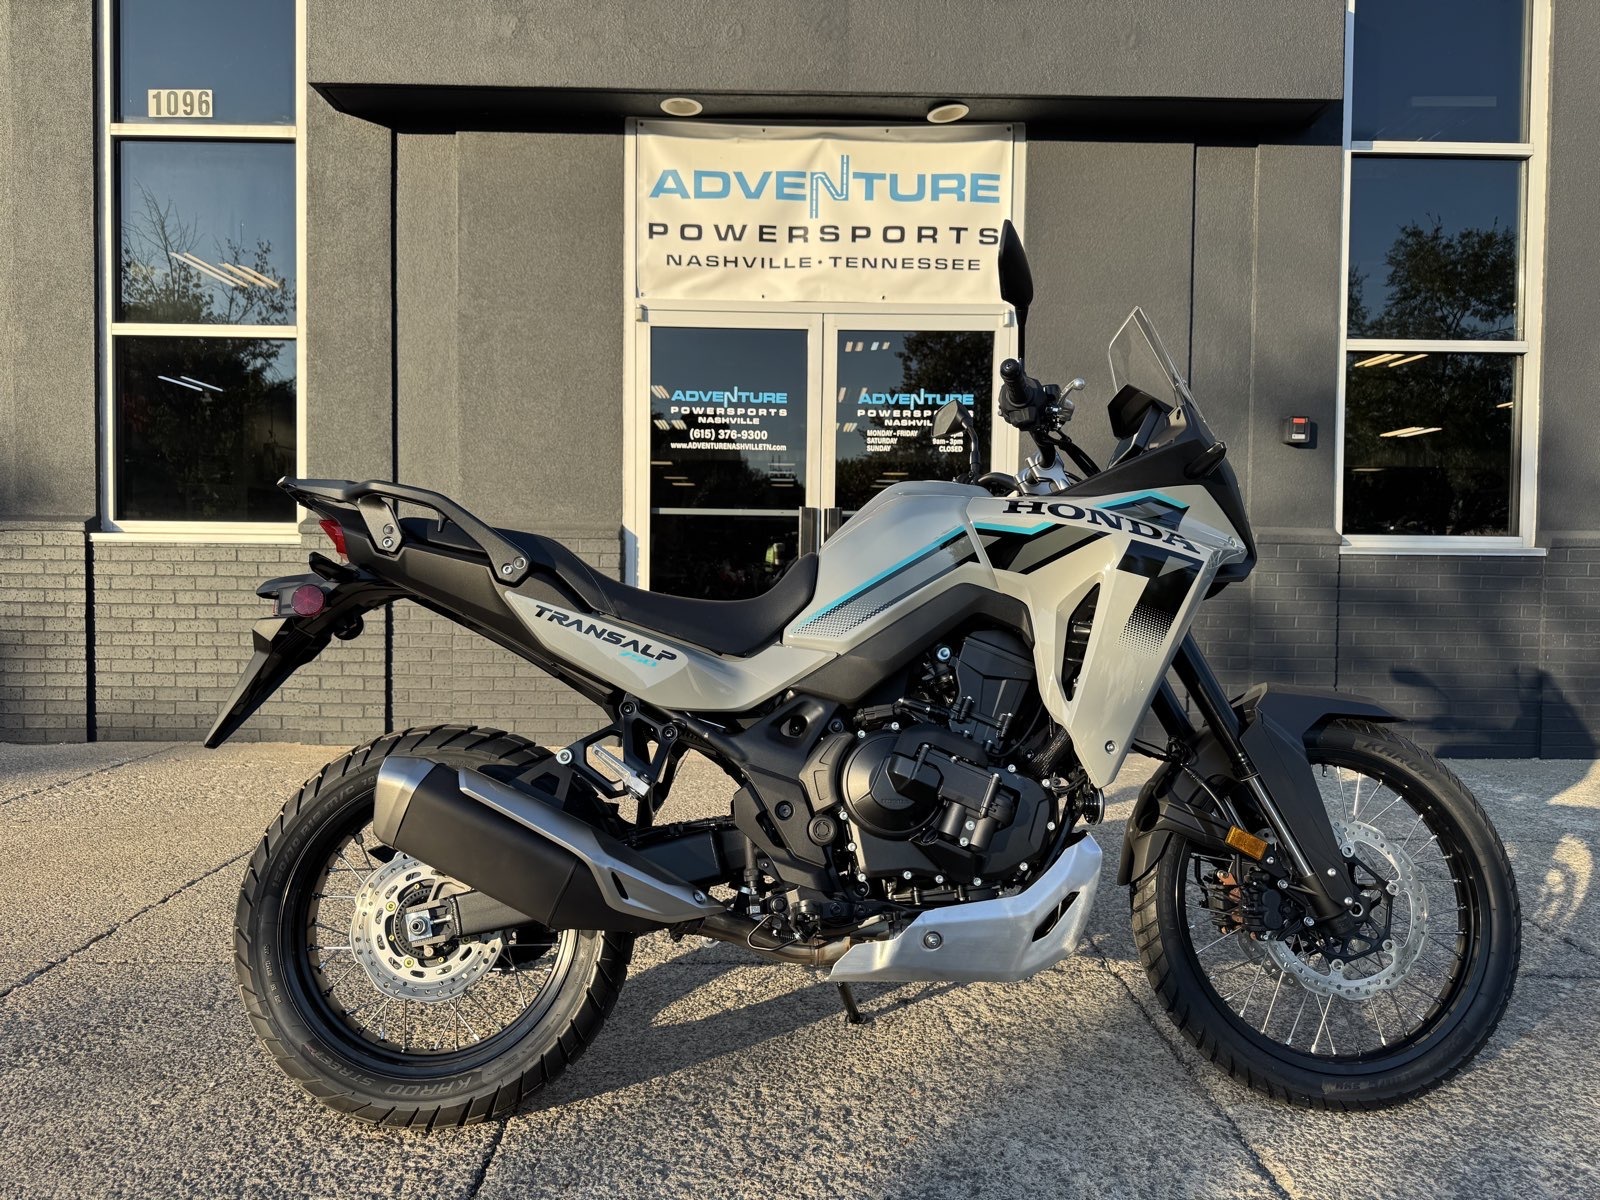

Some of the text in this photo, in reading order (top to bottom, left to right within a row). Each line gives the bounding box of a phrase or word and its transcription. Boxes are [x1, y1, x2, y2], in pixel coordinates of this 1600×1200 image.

[152, 90, 210, 116] 1096
[649, 154, 1000, 218] ADVENTURE
[648, 222, 999, 245] POWERSPORTS
[671, 386, 788, 408] ADVENTURE
[670, 406, 788, 416] POWERSPORTS
[698, 416, 760, 425] NASHVILLE
[689, 428, 768, 440] (615) 376-9300
[866, 437, 898, 445] SATURDAY
[938, 445, 964, 453] CLOSED
[1003, 500, 1201, 555] HONDA
[535, 604, 678, 662] TRANSALP
[384, 1075, 472, 1097] KAROO
